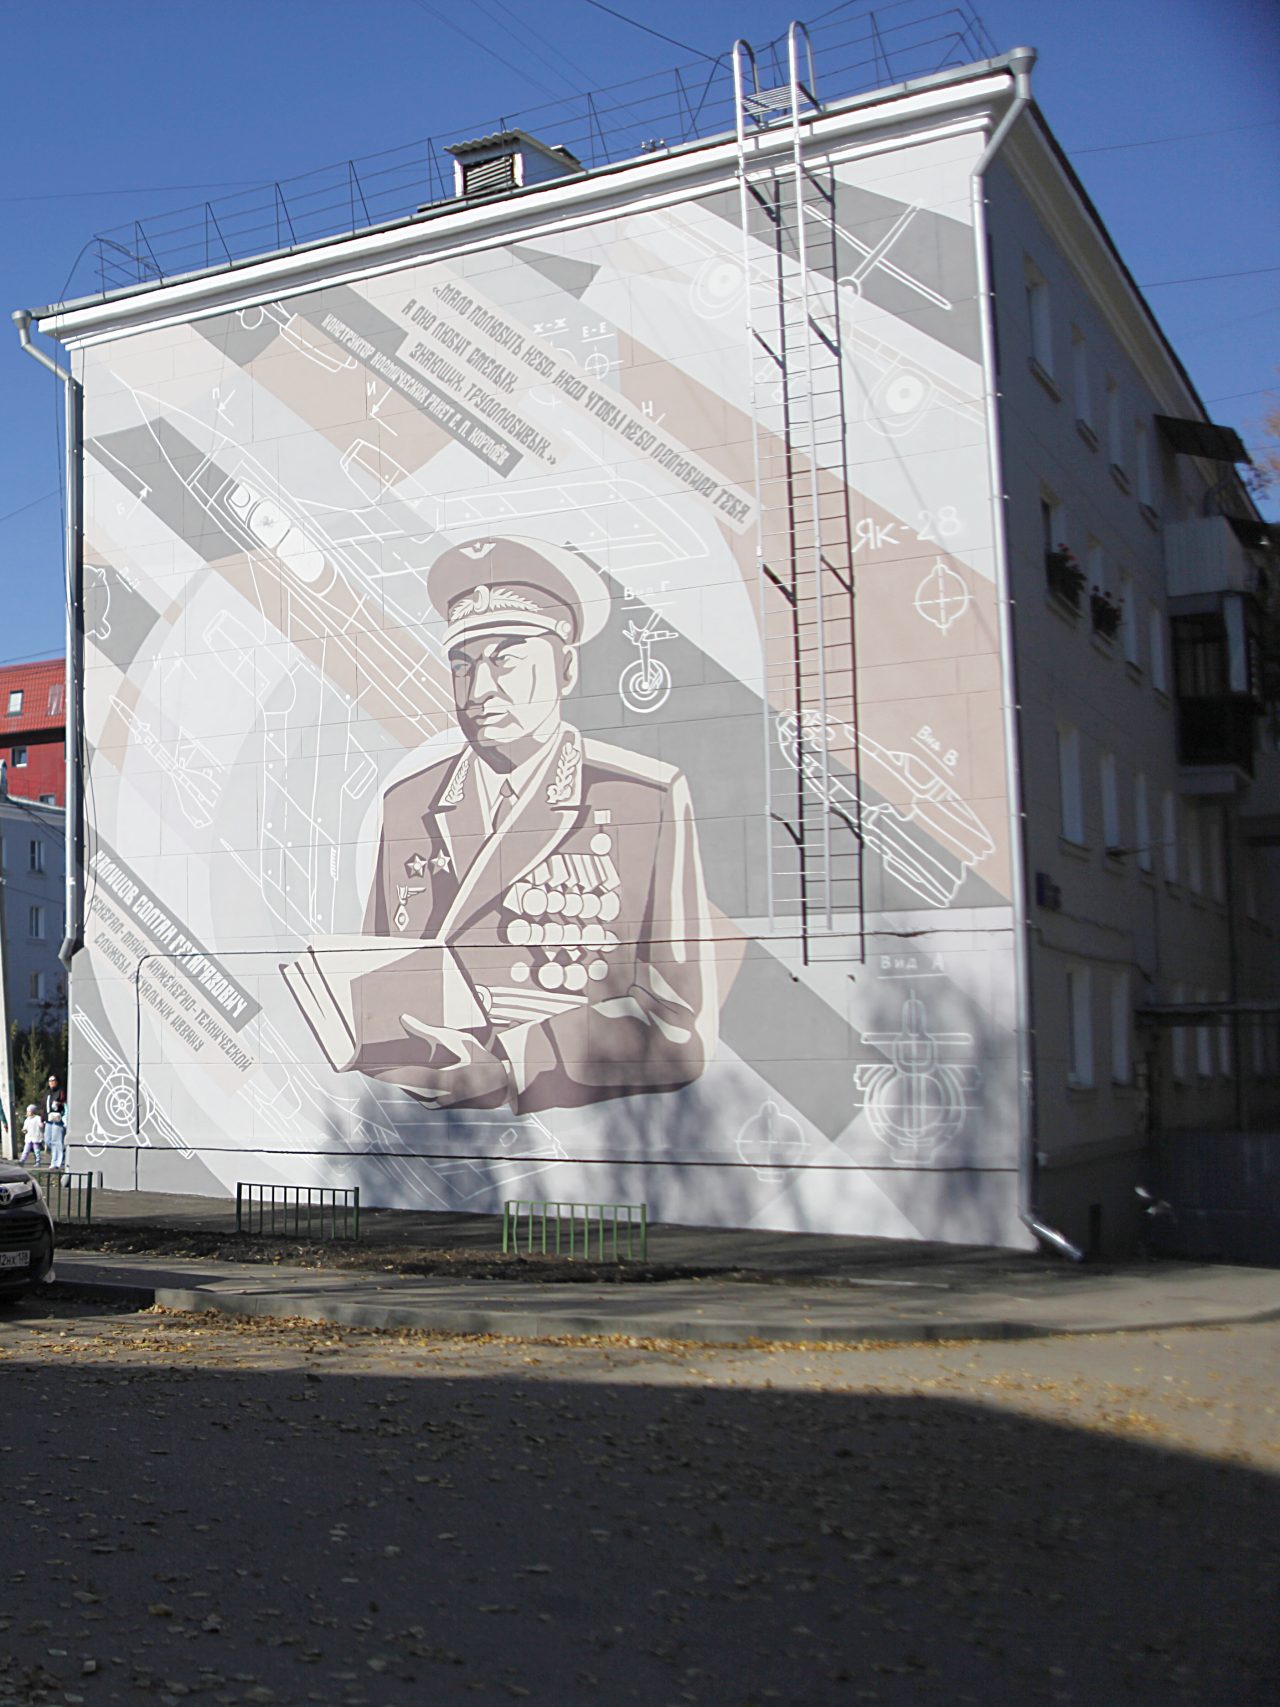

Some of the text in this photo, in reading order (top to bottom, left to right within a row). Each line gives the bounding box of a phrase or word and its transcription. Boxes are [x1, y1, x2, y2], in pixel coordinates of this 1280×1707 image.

[321, 313, 376, 358] КОНСТРУКТОР
[370, 351, 429, 404] КОСМИЧЕСКИХ
[424, 394, 455, 421] РАКЕТ
[401, 298, 519, 394] А ОНО ЛЮБИТ СМЕЛЫХ,
[409, 342, 466, 392] ЗНАЮЩИХ,
[432, 283, 751, 524] «МАЛО ПОЛЮБИТЬ НЕБО, НАДО ЧТОБЫ НЕБО ПОЛЮБИЛО ТЕБЯ.
[87, 895, 152, 961] ГЕНЕРАЛ-МАЙО
[90, 851, 248, 1017] КАЛИЦОВ СОЛТАН ГЕТАГАЗОВИЧ
